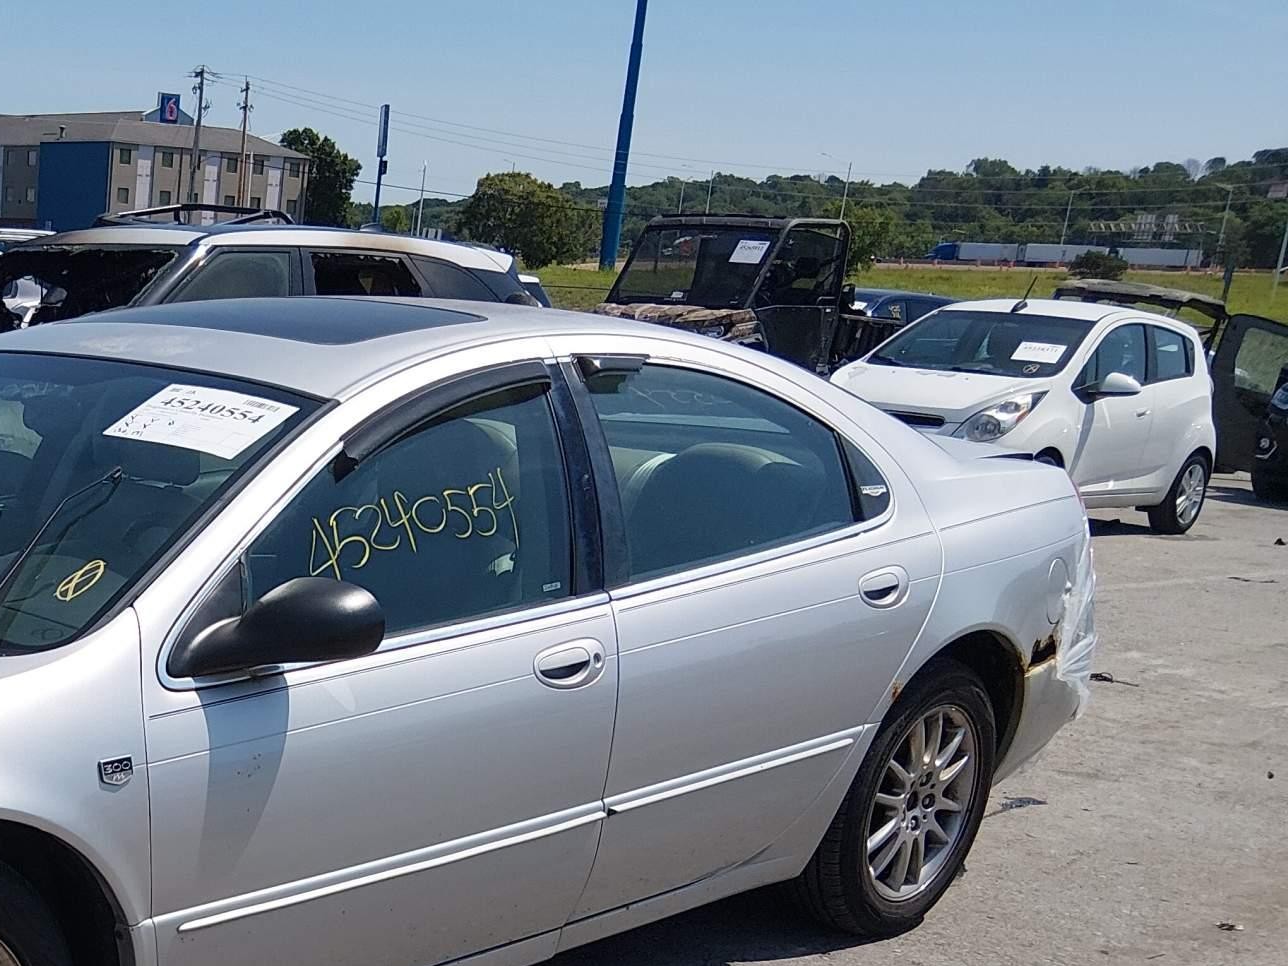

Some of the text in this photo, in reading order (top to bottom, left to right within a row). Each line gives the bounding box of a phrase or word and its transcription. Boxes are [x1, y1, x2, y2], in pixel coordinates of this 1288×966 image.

[166, 98, 178, 121] 6
[160, 396, 266, 424] 45240554
[309, 467, 520, 582] 45240554
[103, 760, 131, 774] 300
